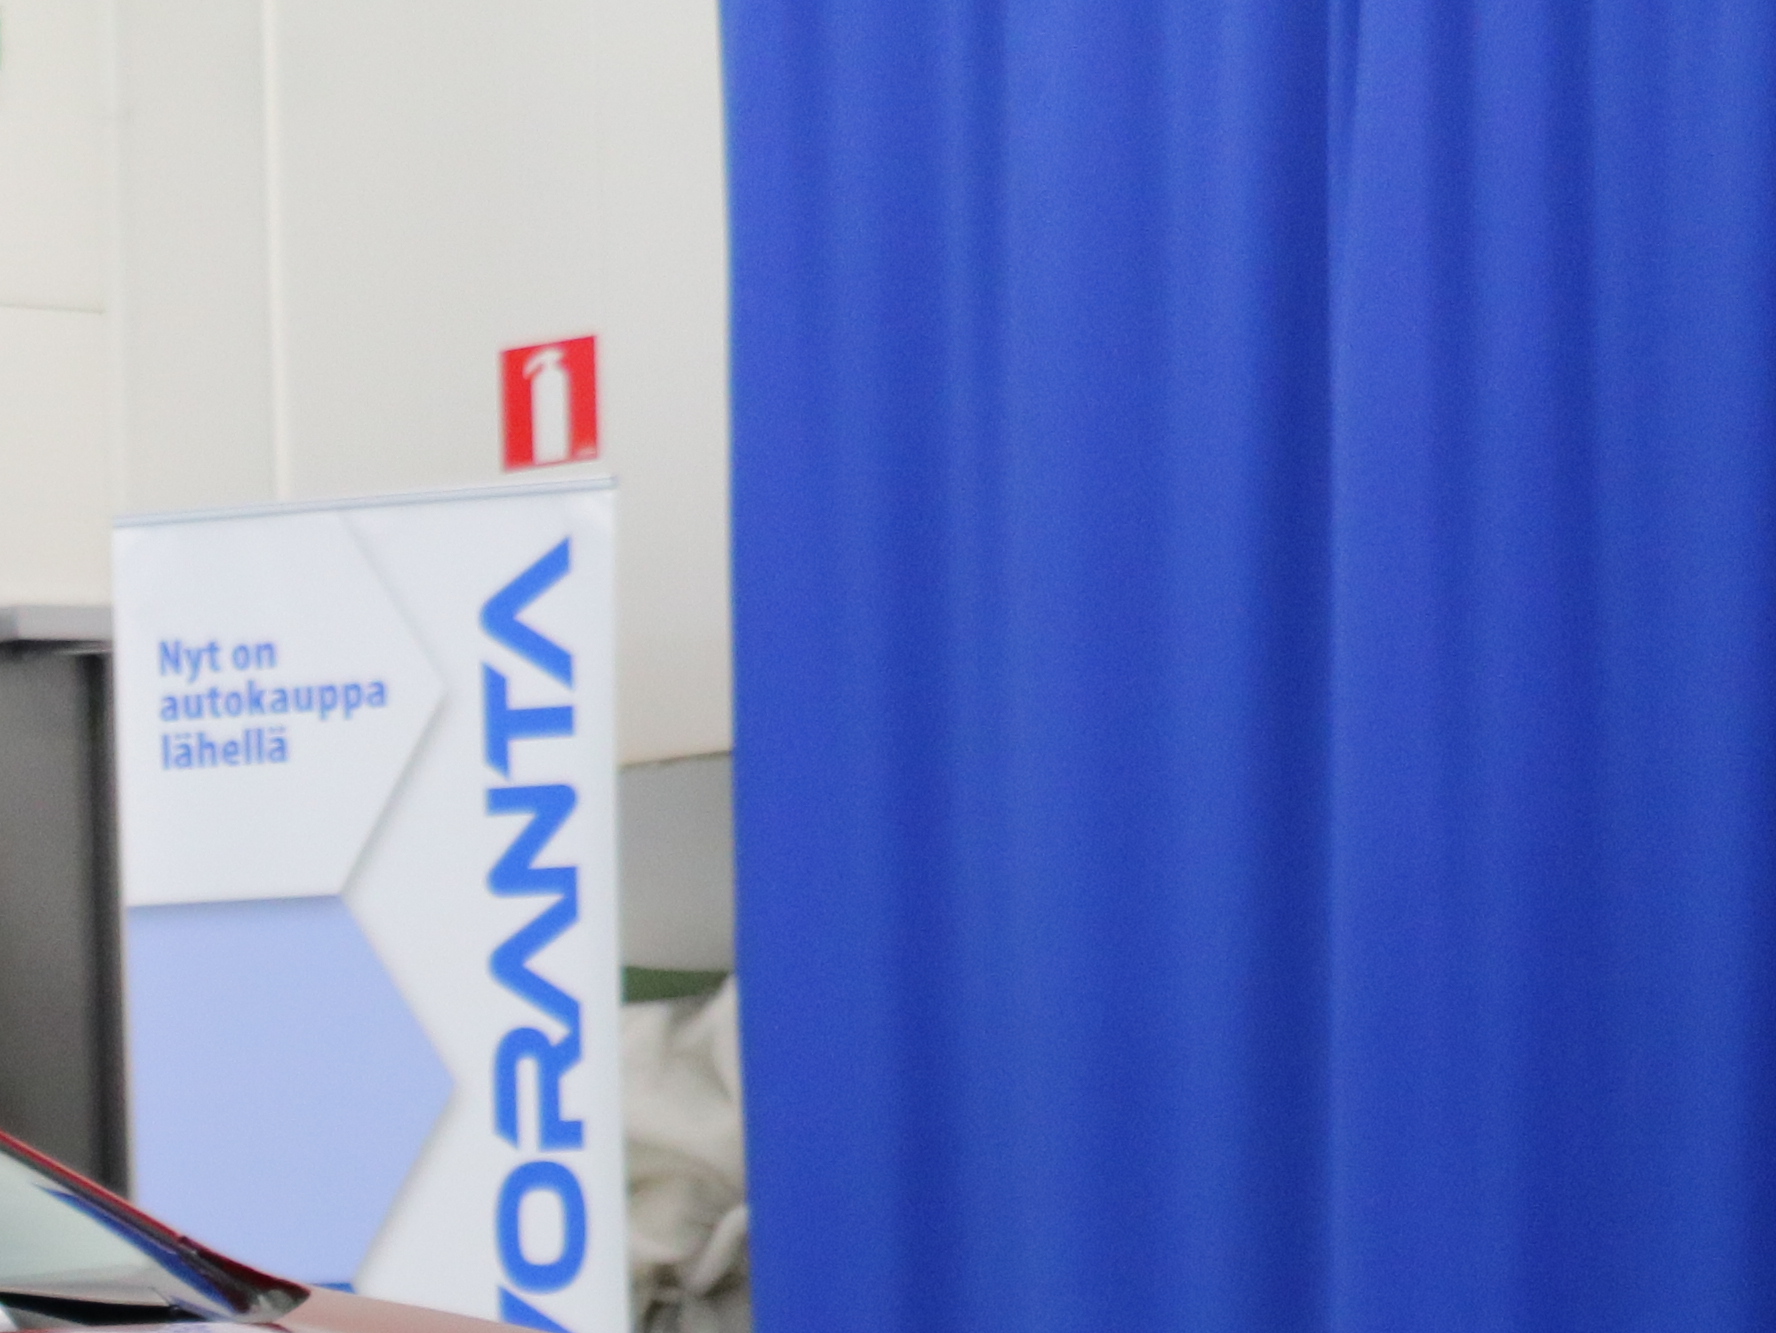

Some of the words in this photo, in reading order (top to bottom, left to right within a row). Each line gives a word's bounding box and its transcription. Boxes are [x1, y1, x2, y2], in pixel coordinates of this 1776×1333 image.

[160, 640, 220, 683] Nyt
[232, 642, 276, 671] on
[160, 680, 387, 721] autokauppa
[162, 726, 288, 769] lähellä
